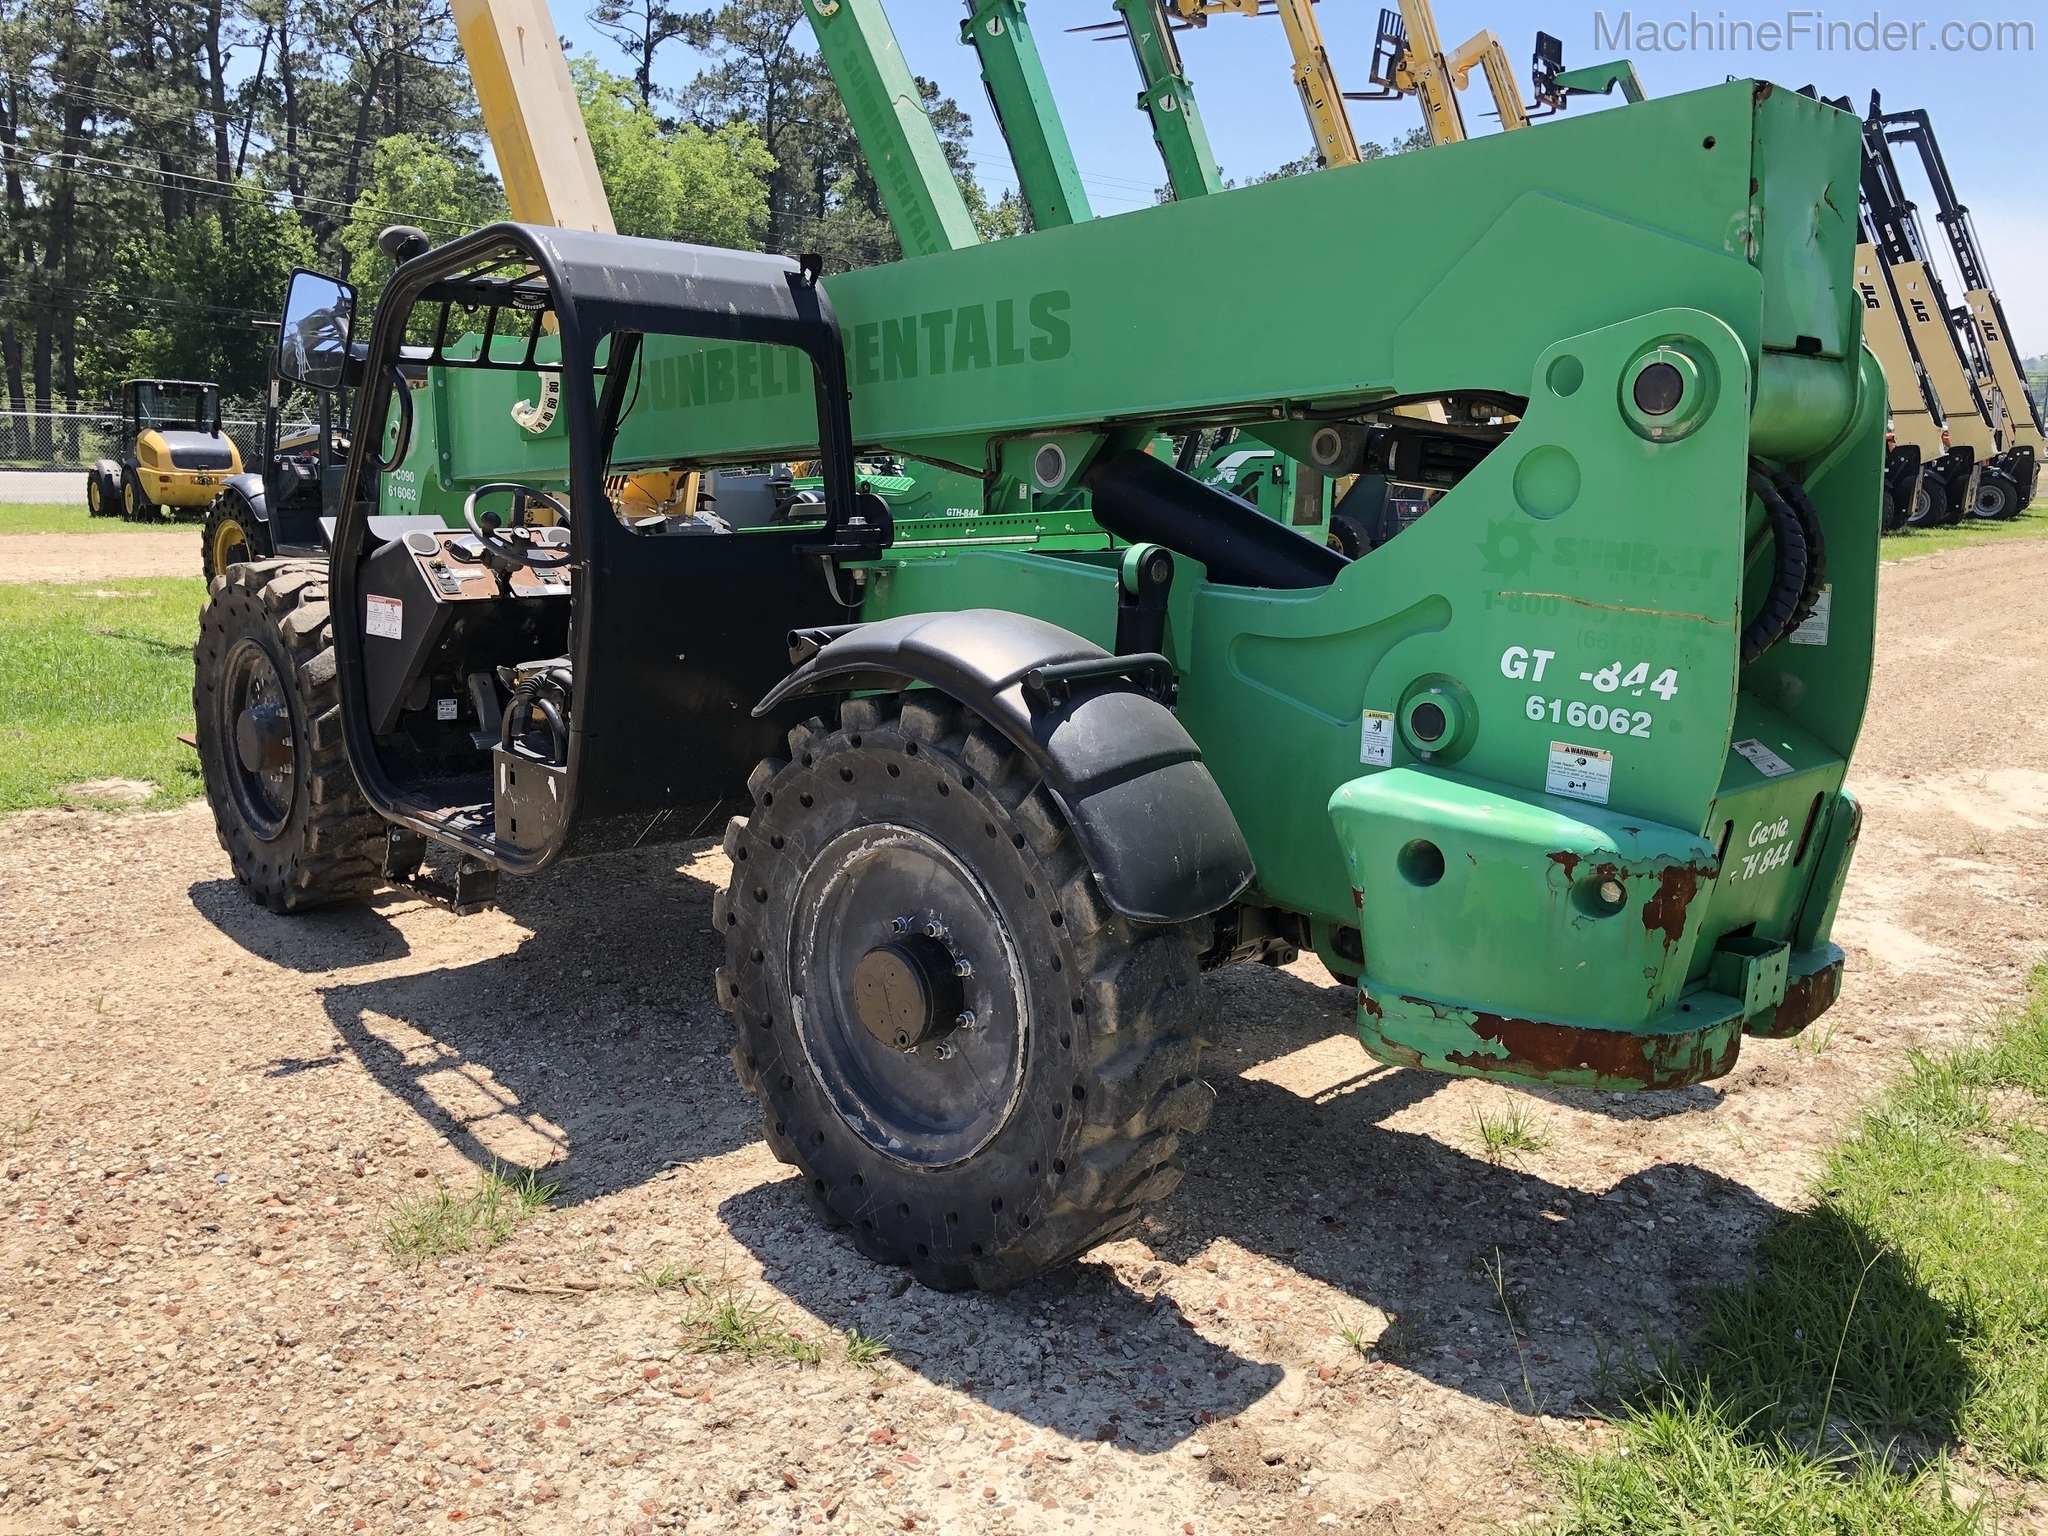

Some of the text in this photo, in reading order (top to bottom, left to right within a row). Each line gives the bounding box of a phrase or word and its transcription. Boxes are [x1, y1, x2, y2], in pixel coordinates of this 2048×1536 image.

[1860, 282, 1880, 308] JLG
[1909, 298, 1931, 322] JLG
[1980, 320, 1998, 342] JLG
[549, 381, 559, 393] 80
[630, 344, 800, 414] SUNBELT
[547, 397, 557, 410] 60
[542, 411, 553, 422] 40
[388, 484, 416, 501] 616062
[946, 507, 979, 518] GTH-844
[1570, 568, 1699, 592] RNTALS
[1525, 695, 1653, 739] 616062
[1570, 747, 1599, 758] WARNING
[1748, 815, 1789, 848] Genie
